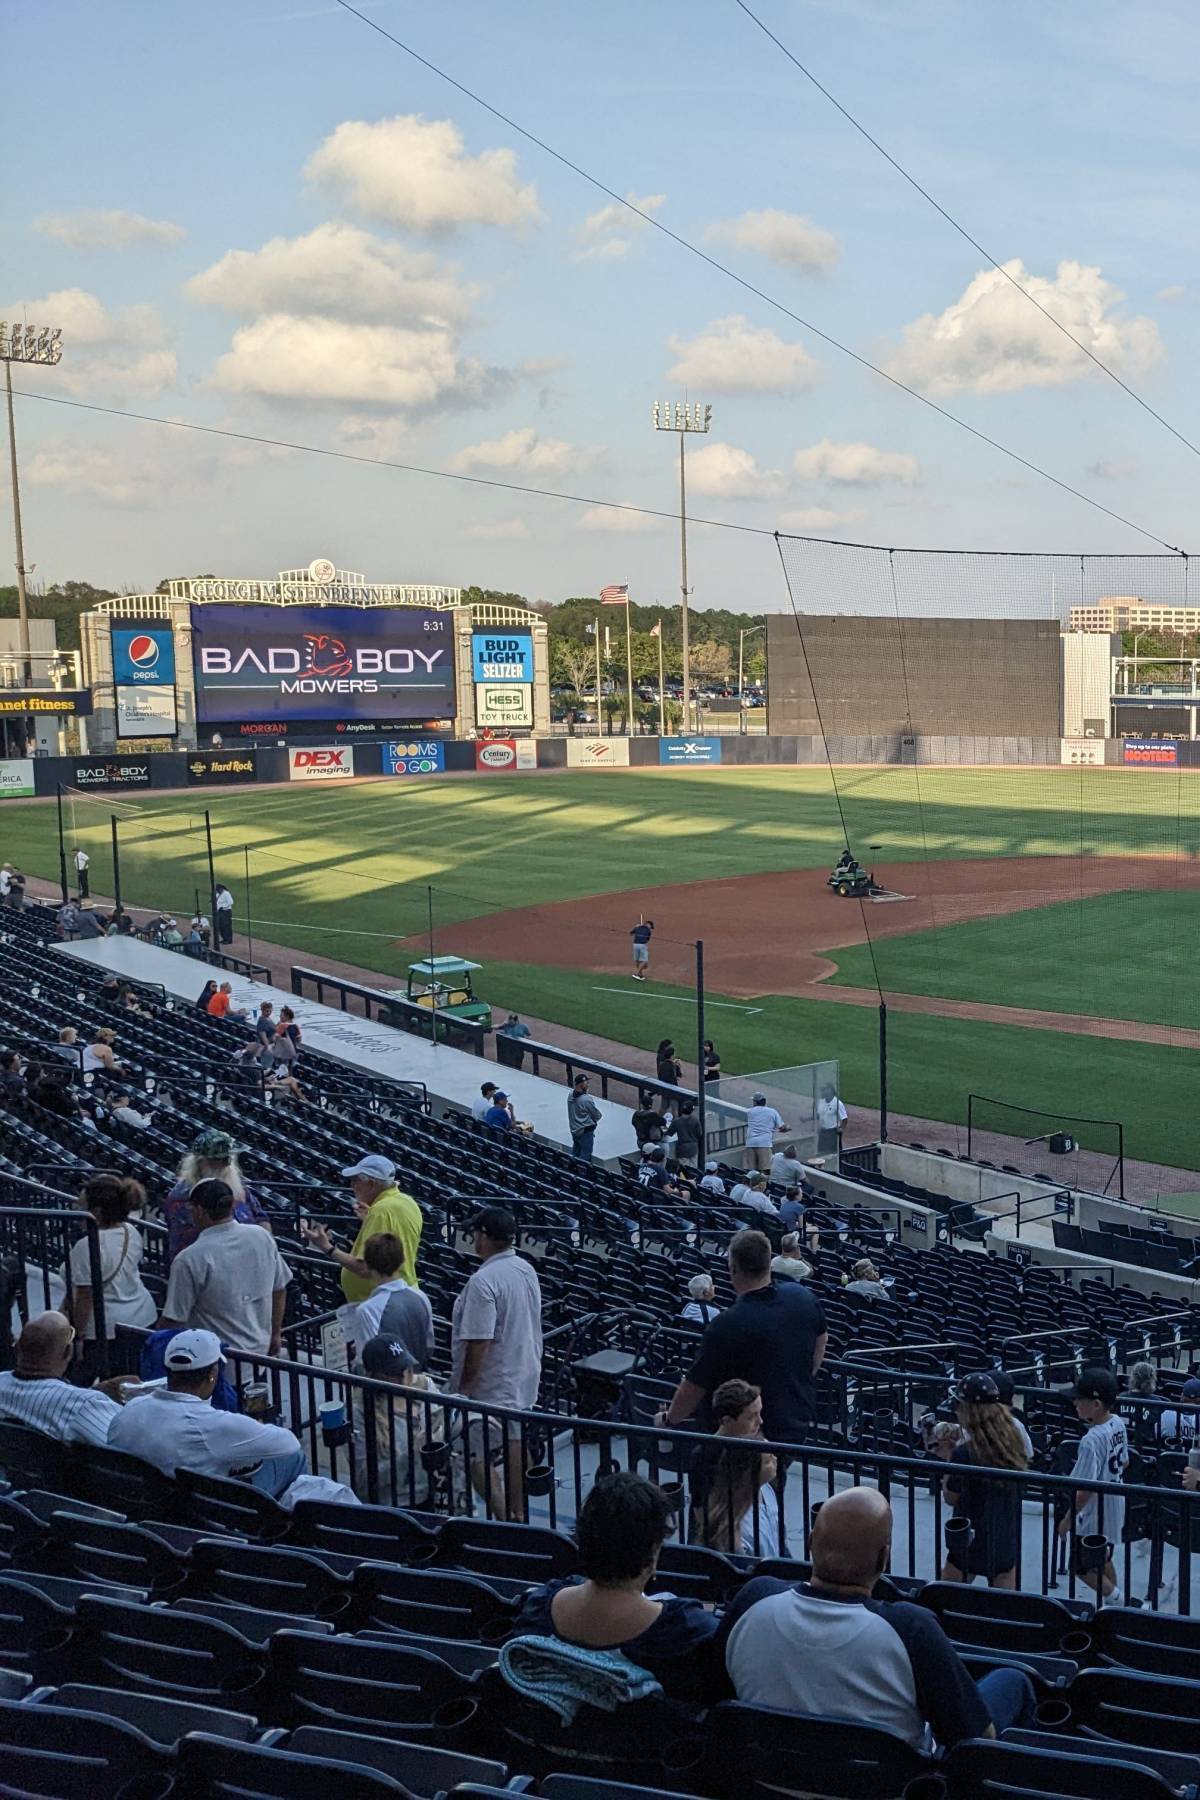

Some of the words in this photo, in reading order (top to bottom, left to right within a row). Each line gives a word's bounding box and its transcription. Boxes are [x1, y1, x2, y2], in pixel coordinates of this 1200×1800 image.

[193, 583, 258, 598] GEORGE
[286, 585, 400, 601] STEINBRENNER
[404, 588, 444, 601] FIELD
[423, 621, 444, 631] 5:31
[485, 640, 519, 651] BUD
[201, 648, 300, 674] BAD
[356, 649, 444, 674] BOY
[479, 652, 527, 663] LIGHT
[133, 670, 159, 680] pepsi
[483, 663, 523, 678] SELTZER
[281, 680, 378, 693] MOWERS
[29, 698, 75, 710] fitness
[489, 696, 520, 704] HESS
[240, 723, 287, 734] MORGAN
[346, 724, 375, 732] AnyDesk
[390, 743, 437, 757] ROOMS
[483, 750, 511, 761] Century
[294, 751, 344, 767] DEX
[1125, 750, 1176, 762] HOOTERS
[77, 768, 105, 778] BAD
[120, 766, 147, 776] BOY
[211, 761, 232, 772] Hard
[233, 761, 253, 772] Rock
[306, 766, 350, 775] imaging
[390, 761, 406, 774] TO
[409, 760, 432, 773] GO
